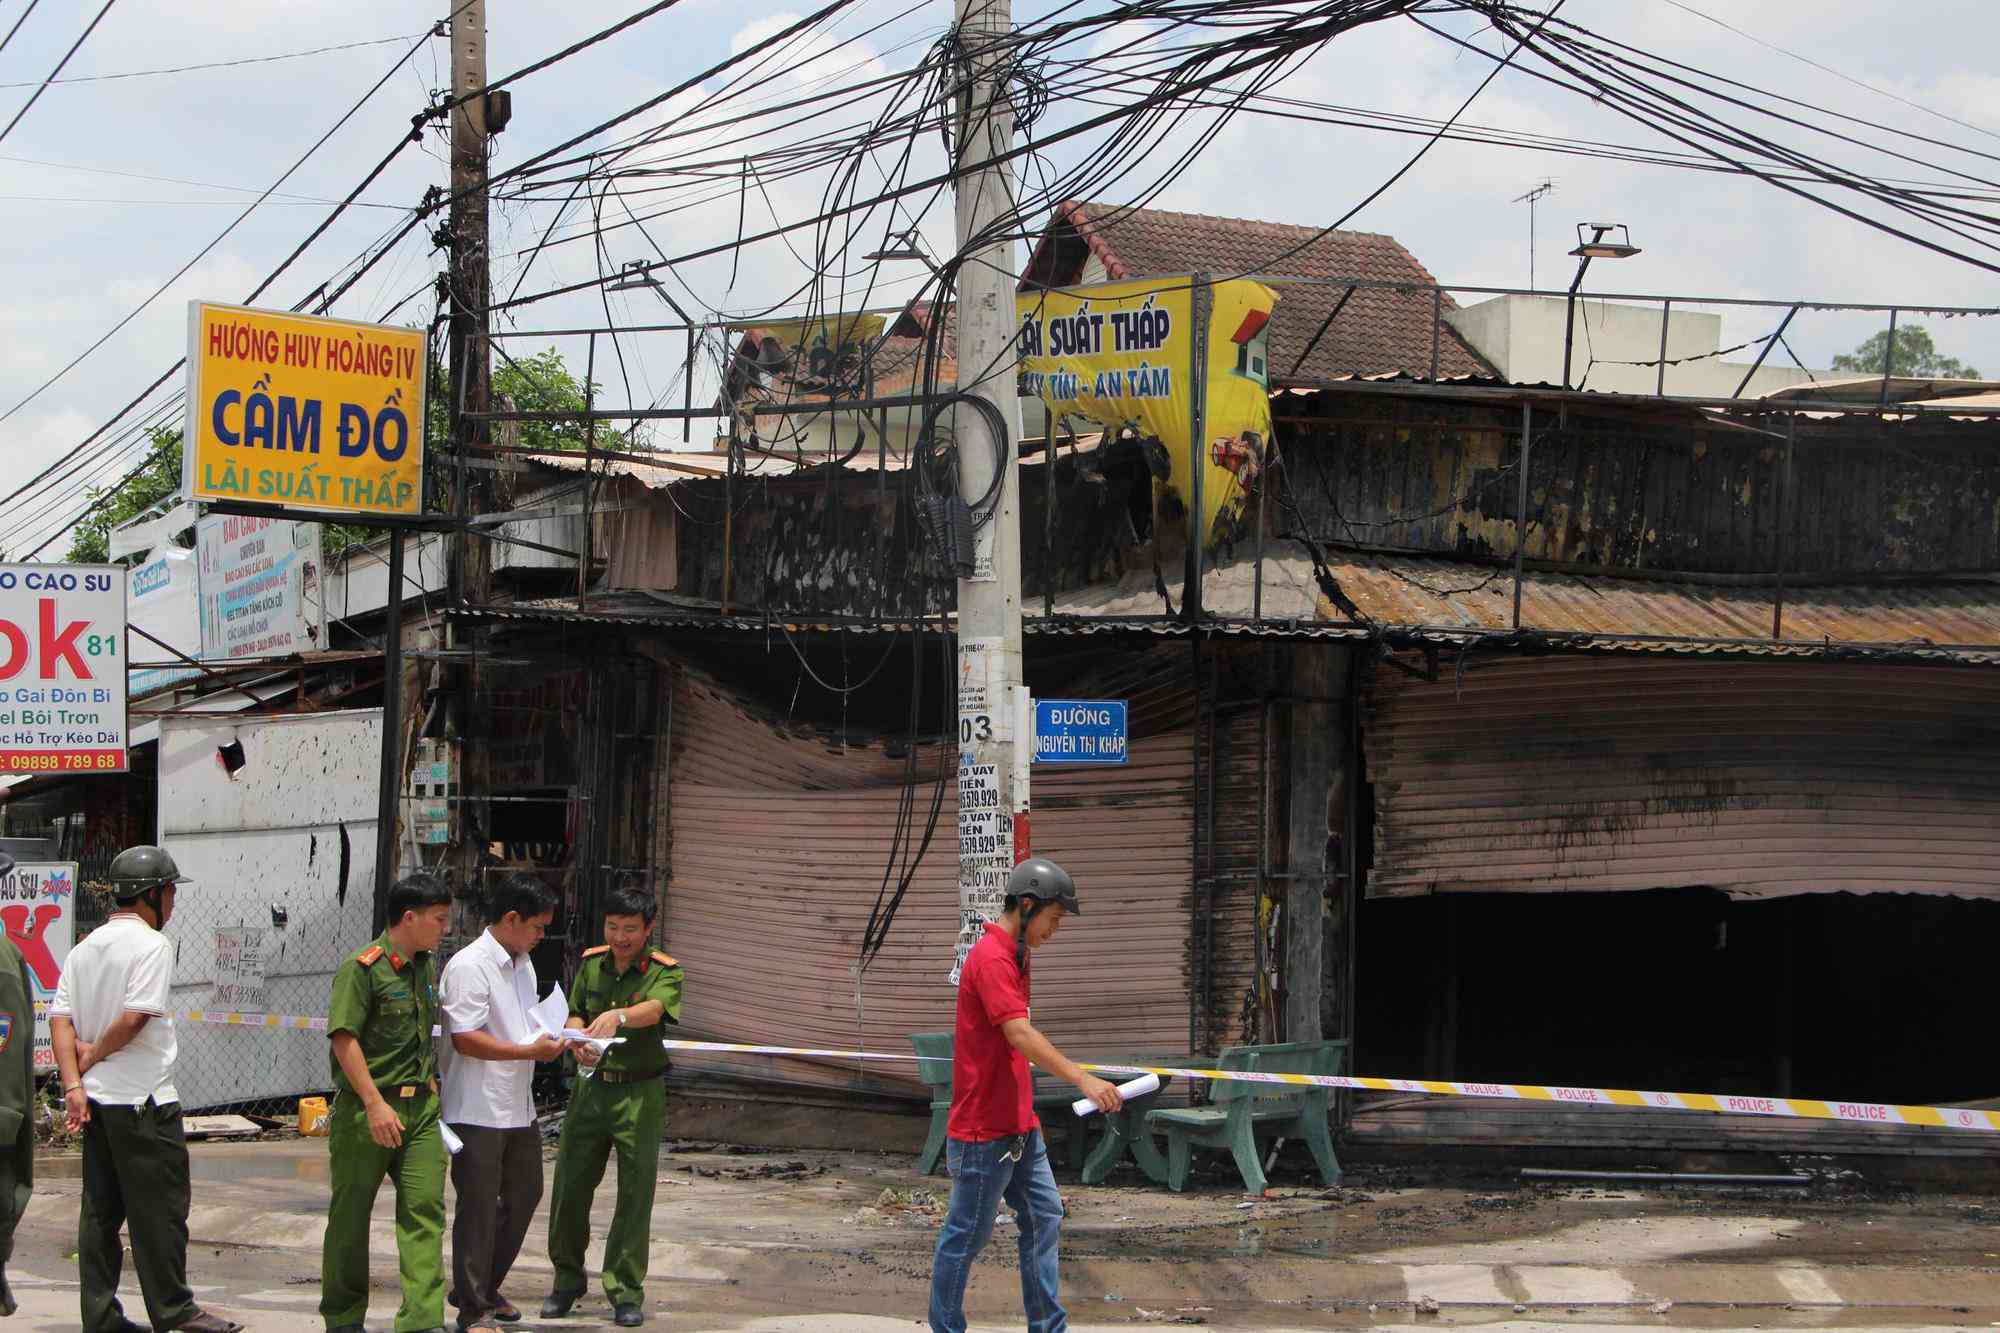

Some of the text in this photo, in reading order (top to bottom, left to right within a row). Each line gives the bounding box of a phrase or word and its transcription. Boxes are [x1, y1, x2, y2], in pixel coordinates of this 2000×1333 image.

[1049, 302, 1103, 357] SUẤT
[1111, 296, 1169, 351] THẤP
[209, 321, 279, 364] HƯƠNG
[285, 333, 321, 369] HUY
[326, 332, 393, 378] HOÀNG
[1094, 371, 1121, 398] AN
[1128, 362, 1169, 396] TÂM
[212, 373, 409, 462] CẦM ĐỒ
[205, 459, 415, 508] LÃI SUẤT THẤP
[26, 573, 77, 591] CAO
[85, 574, 111, 591] SU
[87, 635, 116, 656] 81
[16, 688, 45, 703] Gai
[93, 688, 111, 703] Bi
[22, 710, 51, 725] Bôi
[58, 710, 99, 725] Trơn
[1051, 705, 1111, 726] ĐƯỜNG
[38, 732, 62, 747] Trợ
[961, 715, 992, 743] 03
[1036, 727, 1076, 753] NGUYỄN
[1080, 735, 1096, 756] THỊ
[11, 754, 116, 769] 09898 789 68
[972, 766, 994, 775] VAY
[970, 812, 992, 822] VAY
[1464, 1082, 1504, 1096] POLICE
[1556, 1087, 1598, 1101] POLICE
[1728, 1097, 1774, 1112] POLICE
[1839, 1103, 1887, 1119] POLICE
